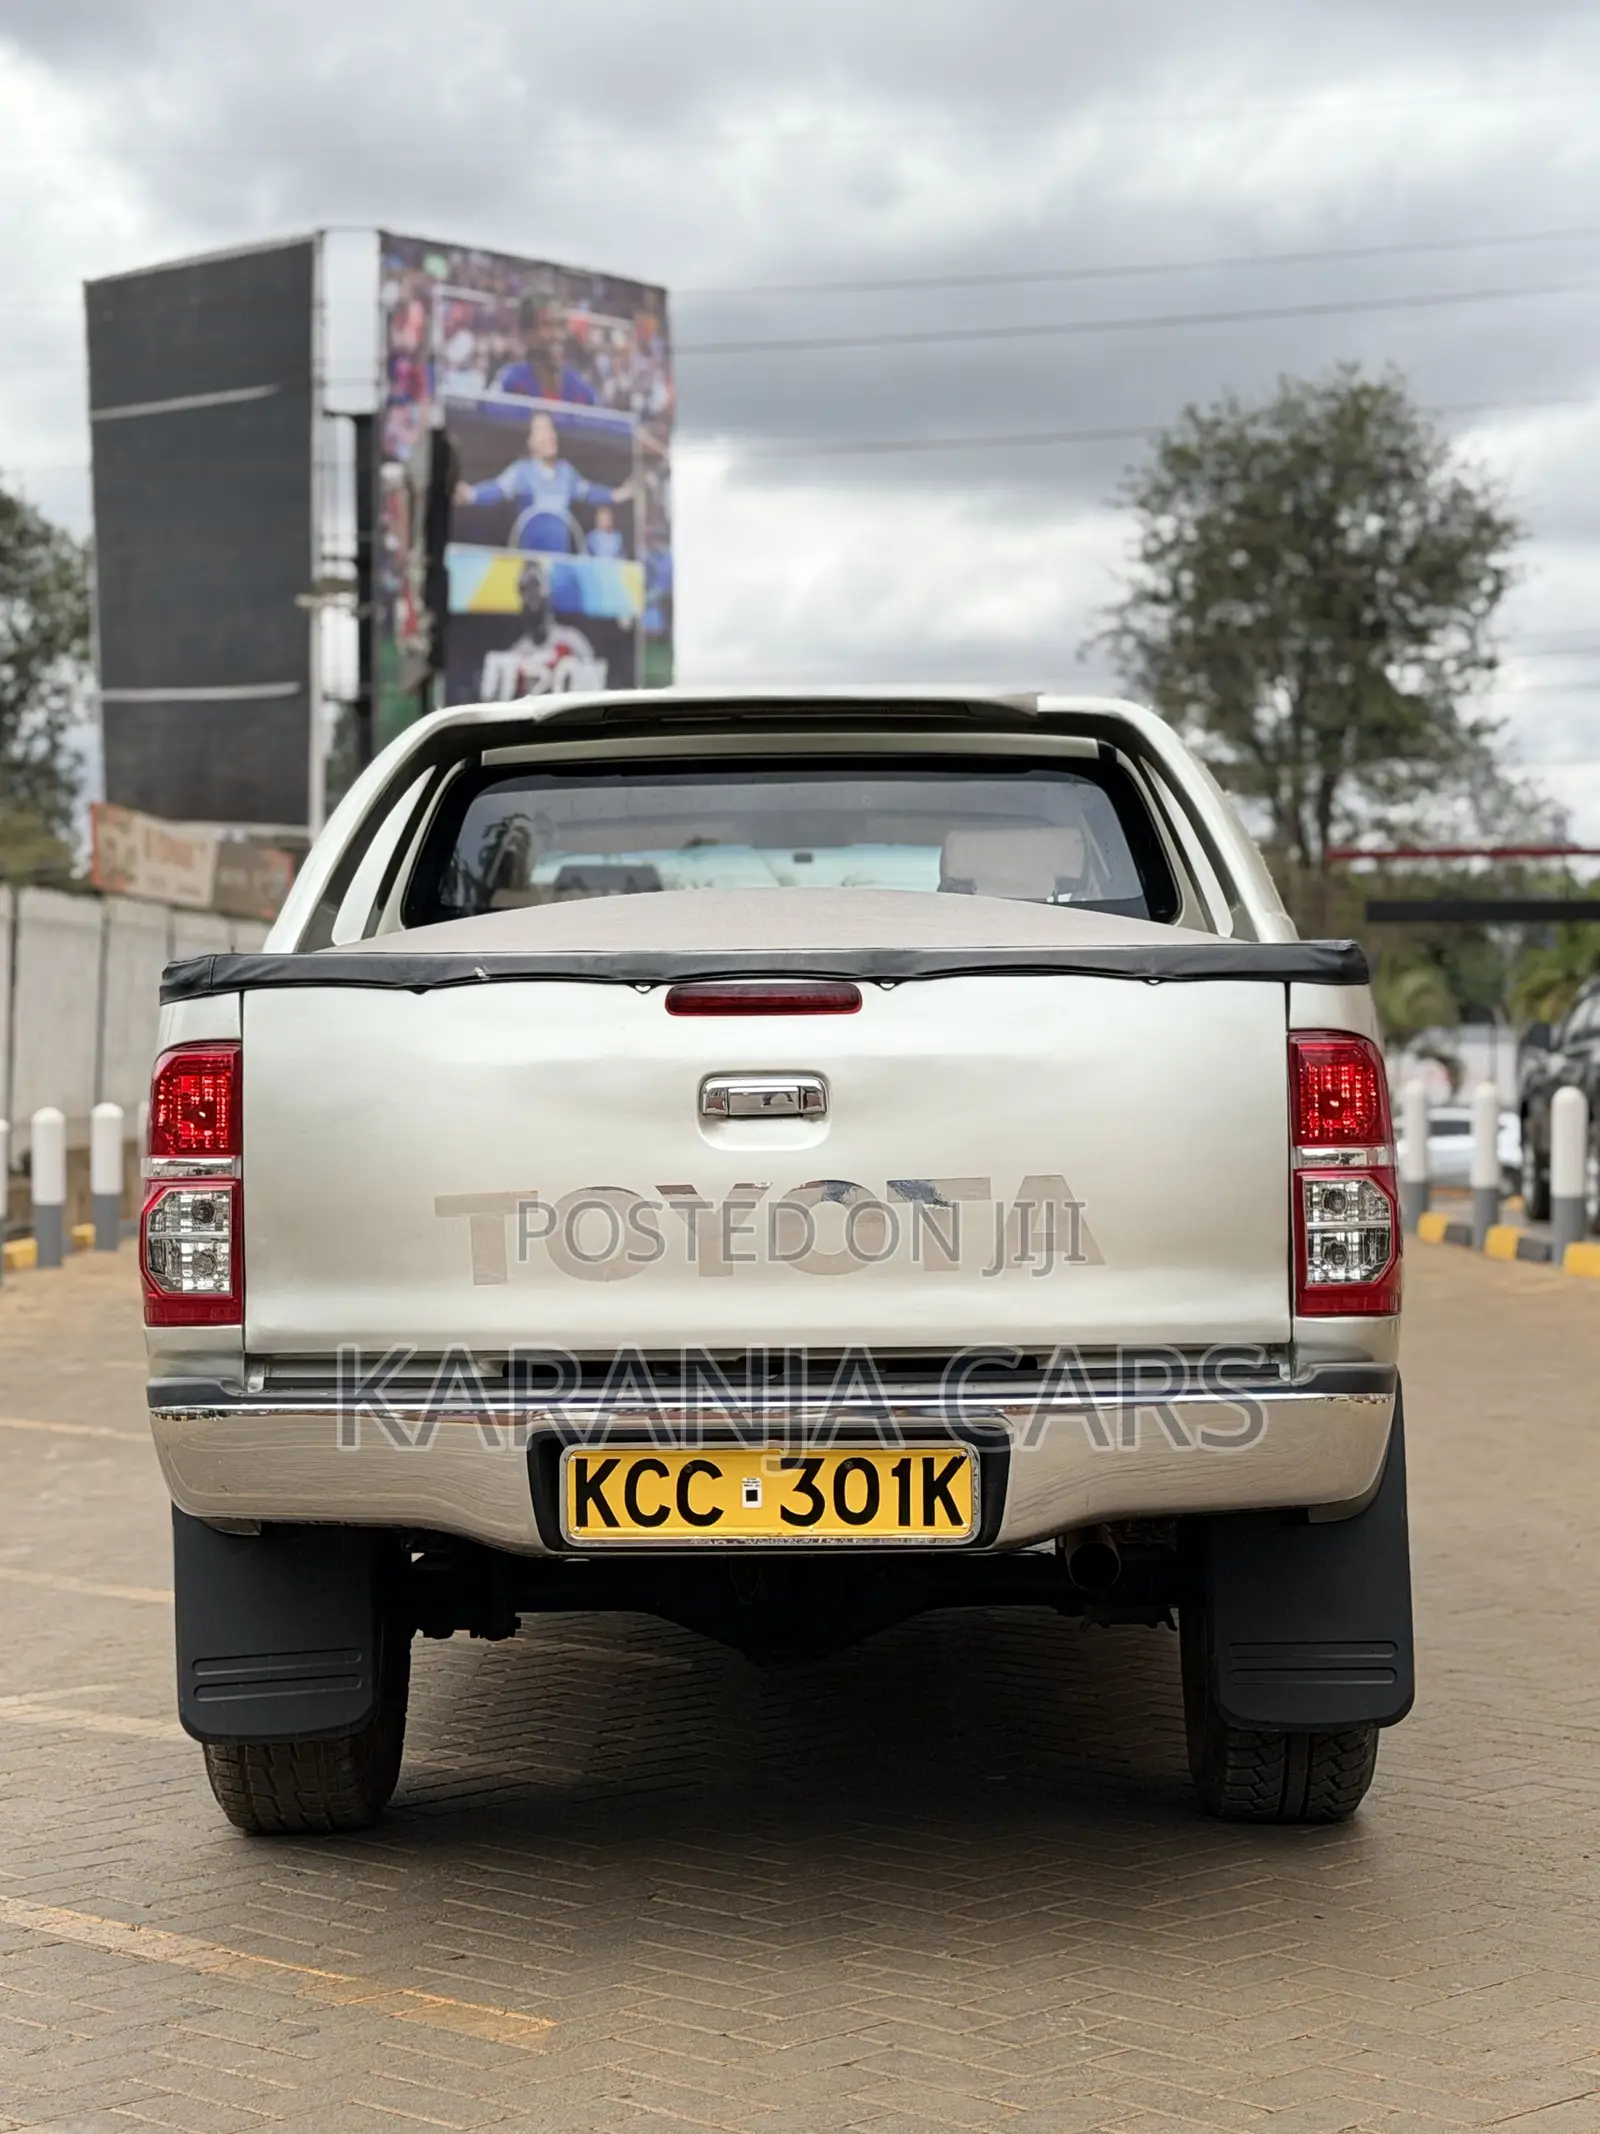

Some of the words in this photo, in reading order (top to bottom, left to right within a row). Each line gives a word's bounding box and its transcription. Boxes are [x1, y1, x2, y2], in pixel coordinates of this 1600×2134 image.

[434, 1174, 1105, 1285] TOYOTA
[573, 1457, 725, 1528] KCC
[780, 1457, 969, 1528] 301K
